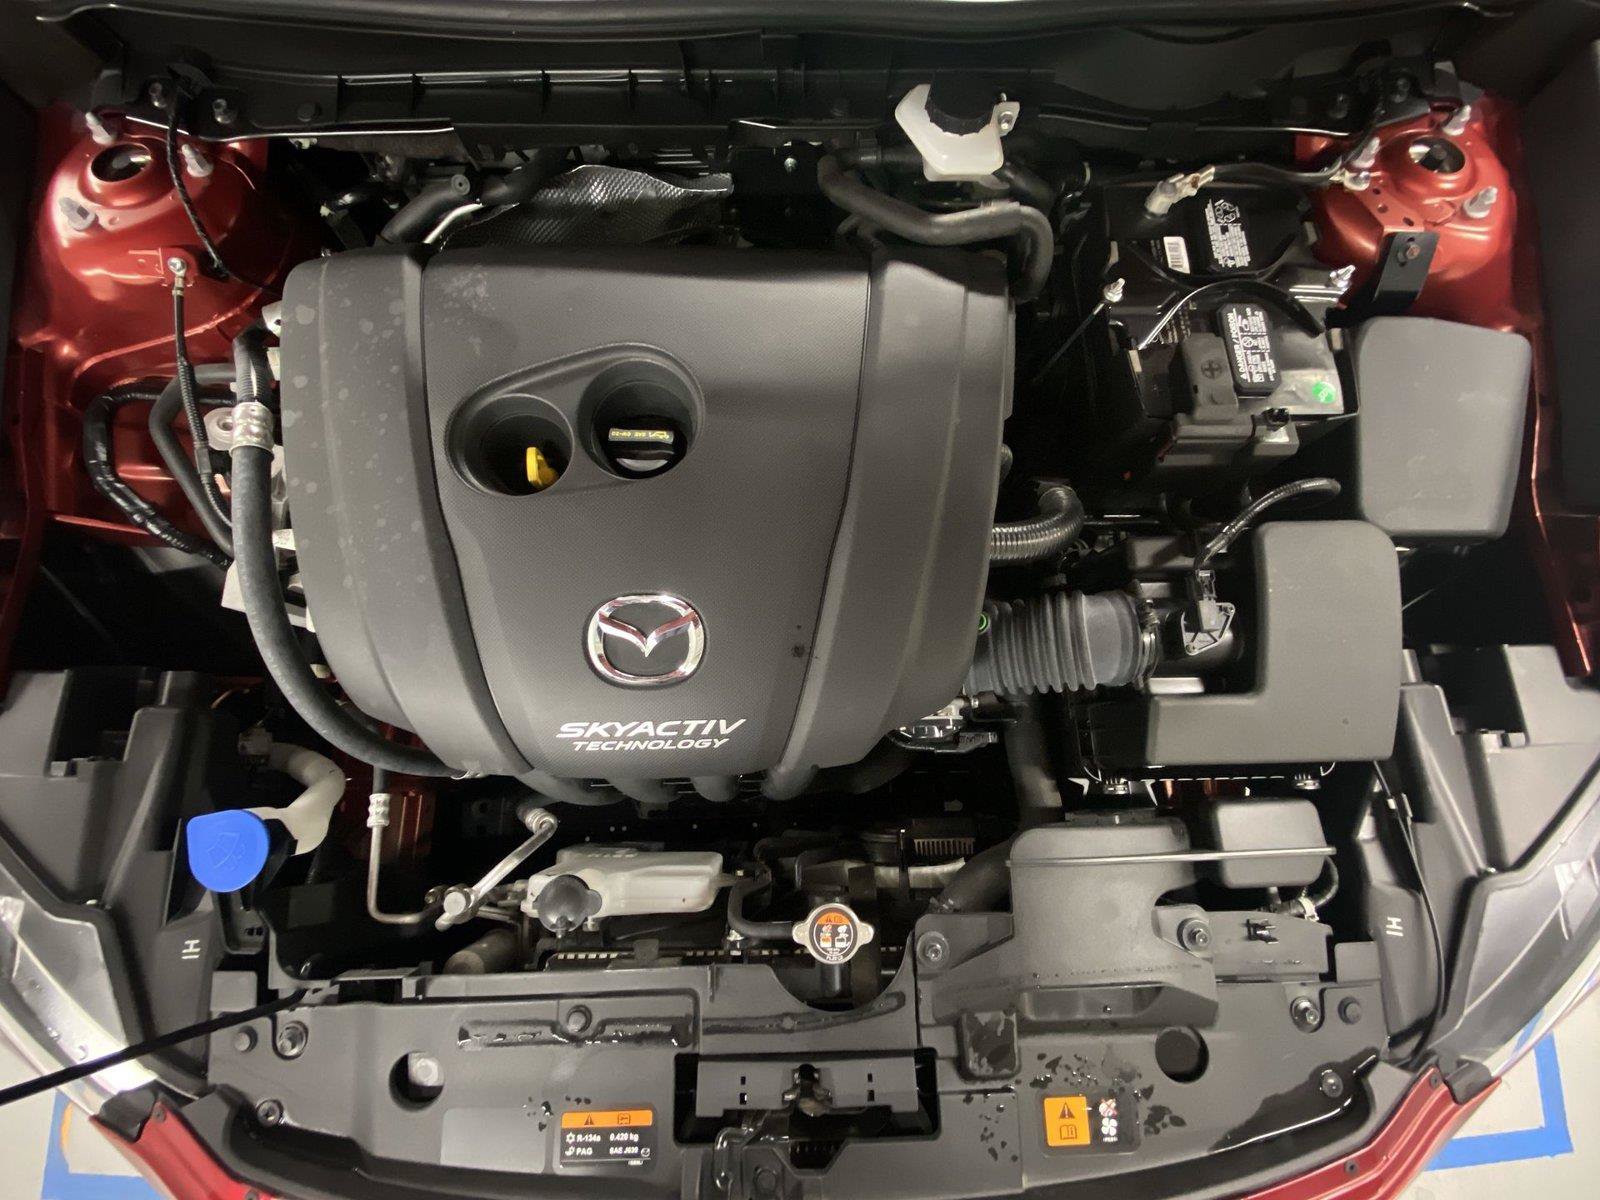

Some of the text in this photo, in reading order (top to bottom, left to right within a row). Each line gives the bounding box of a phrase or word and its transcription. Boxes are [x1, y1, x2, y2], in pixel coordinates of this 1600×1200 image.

[556, 719, 747, 738] SKYACTIV
[573, 738, 730, 751] TECHNOLOGY
[576, 1133, 601, 1142] R-134a
[629, 1132, 639, 1142] kg
[576, 1147, 593, 1156] PAG
